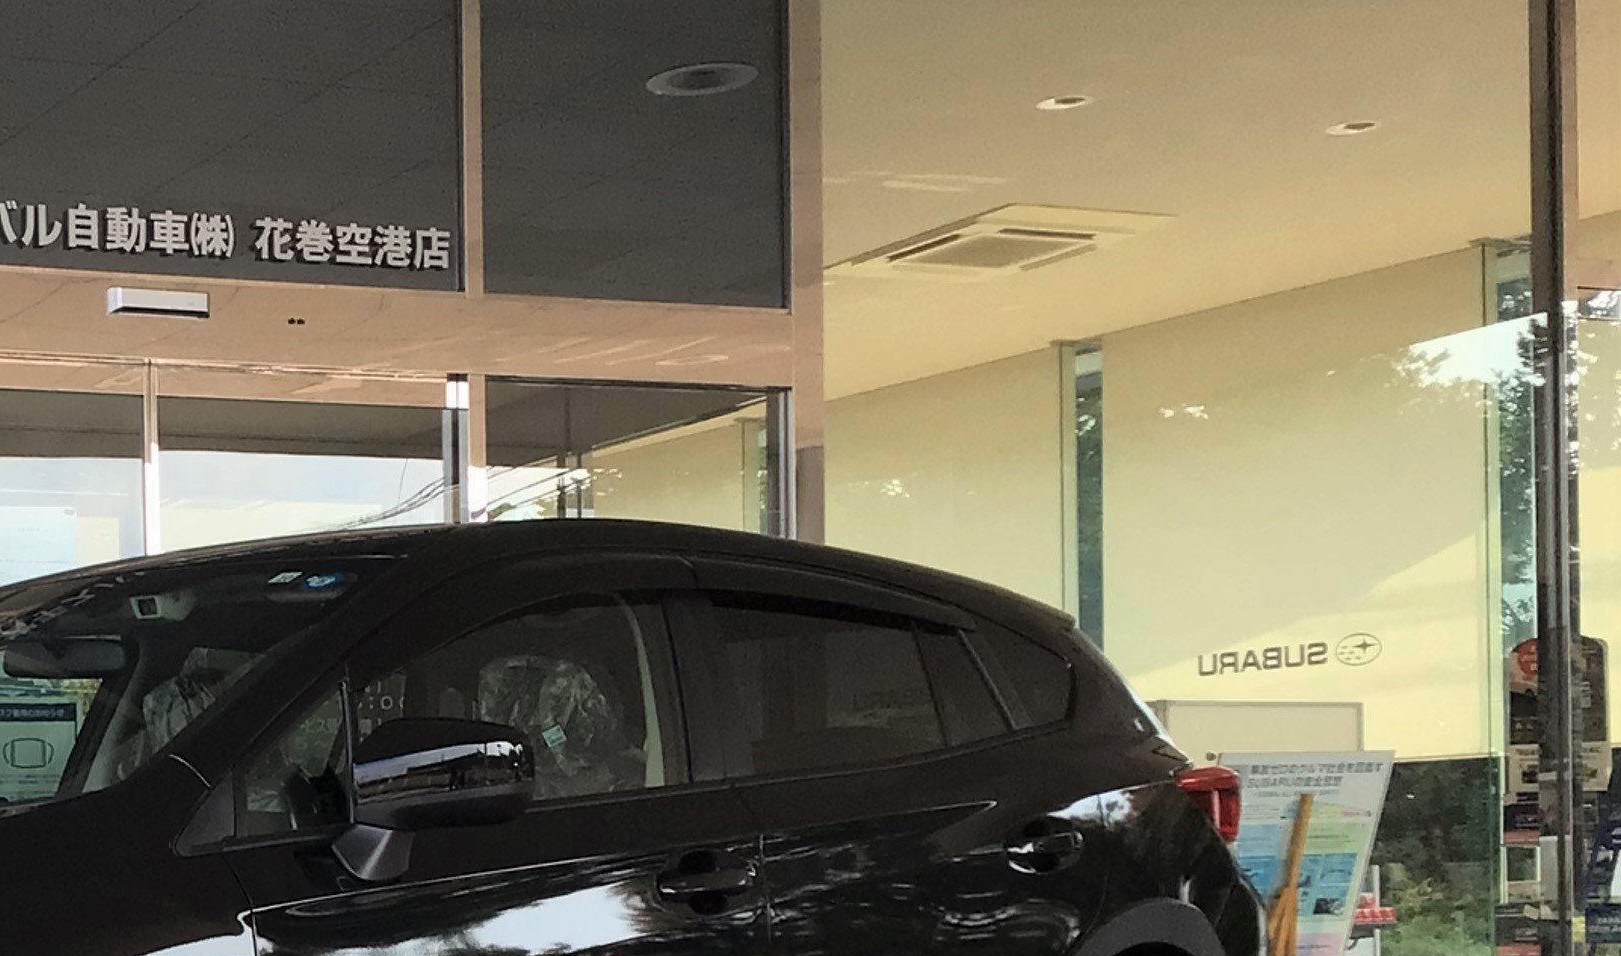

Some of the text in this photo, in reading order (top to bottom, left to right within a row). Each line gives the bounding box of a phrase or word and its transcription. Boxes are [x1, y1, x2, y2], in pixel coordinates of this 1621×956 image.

[254, 215, 451, 269] 花巻空港店
